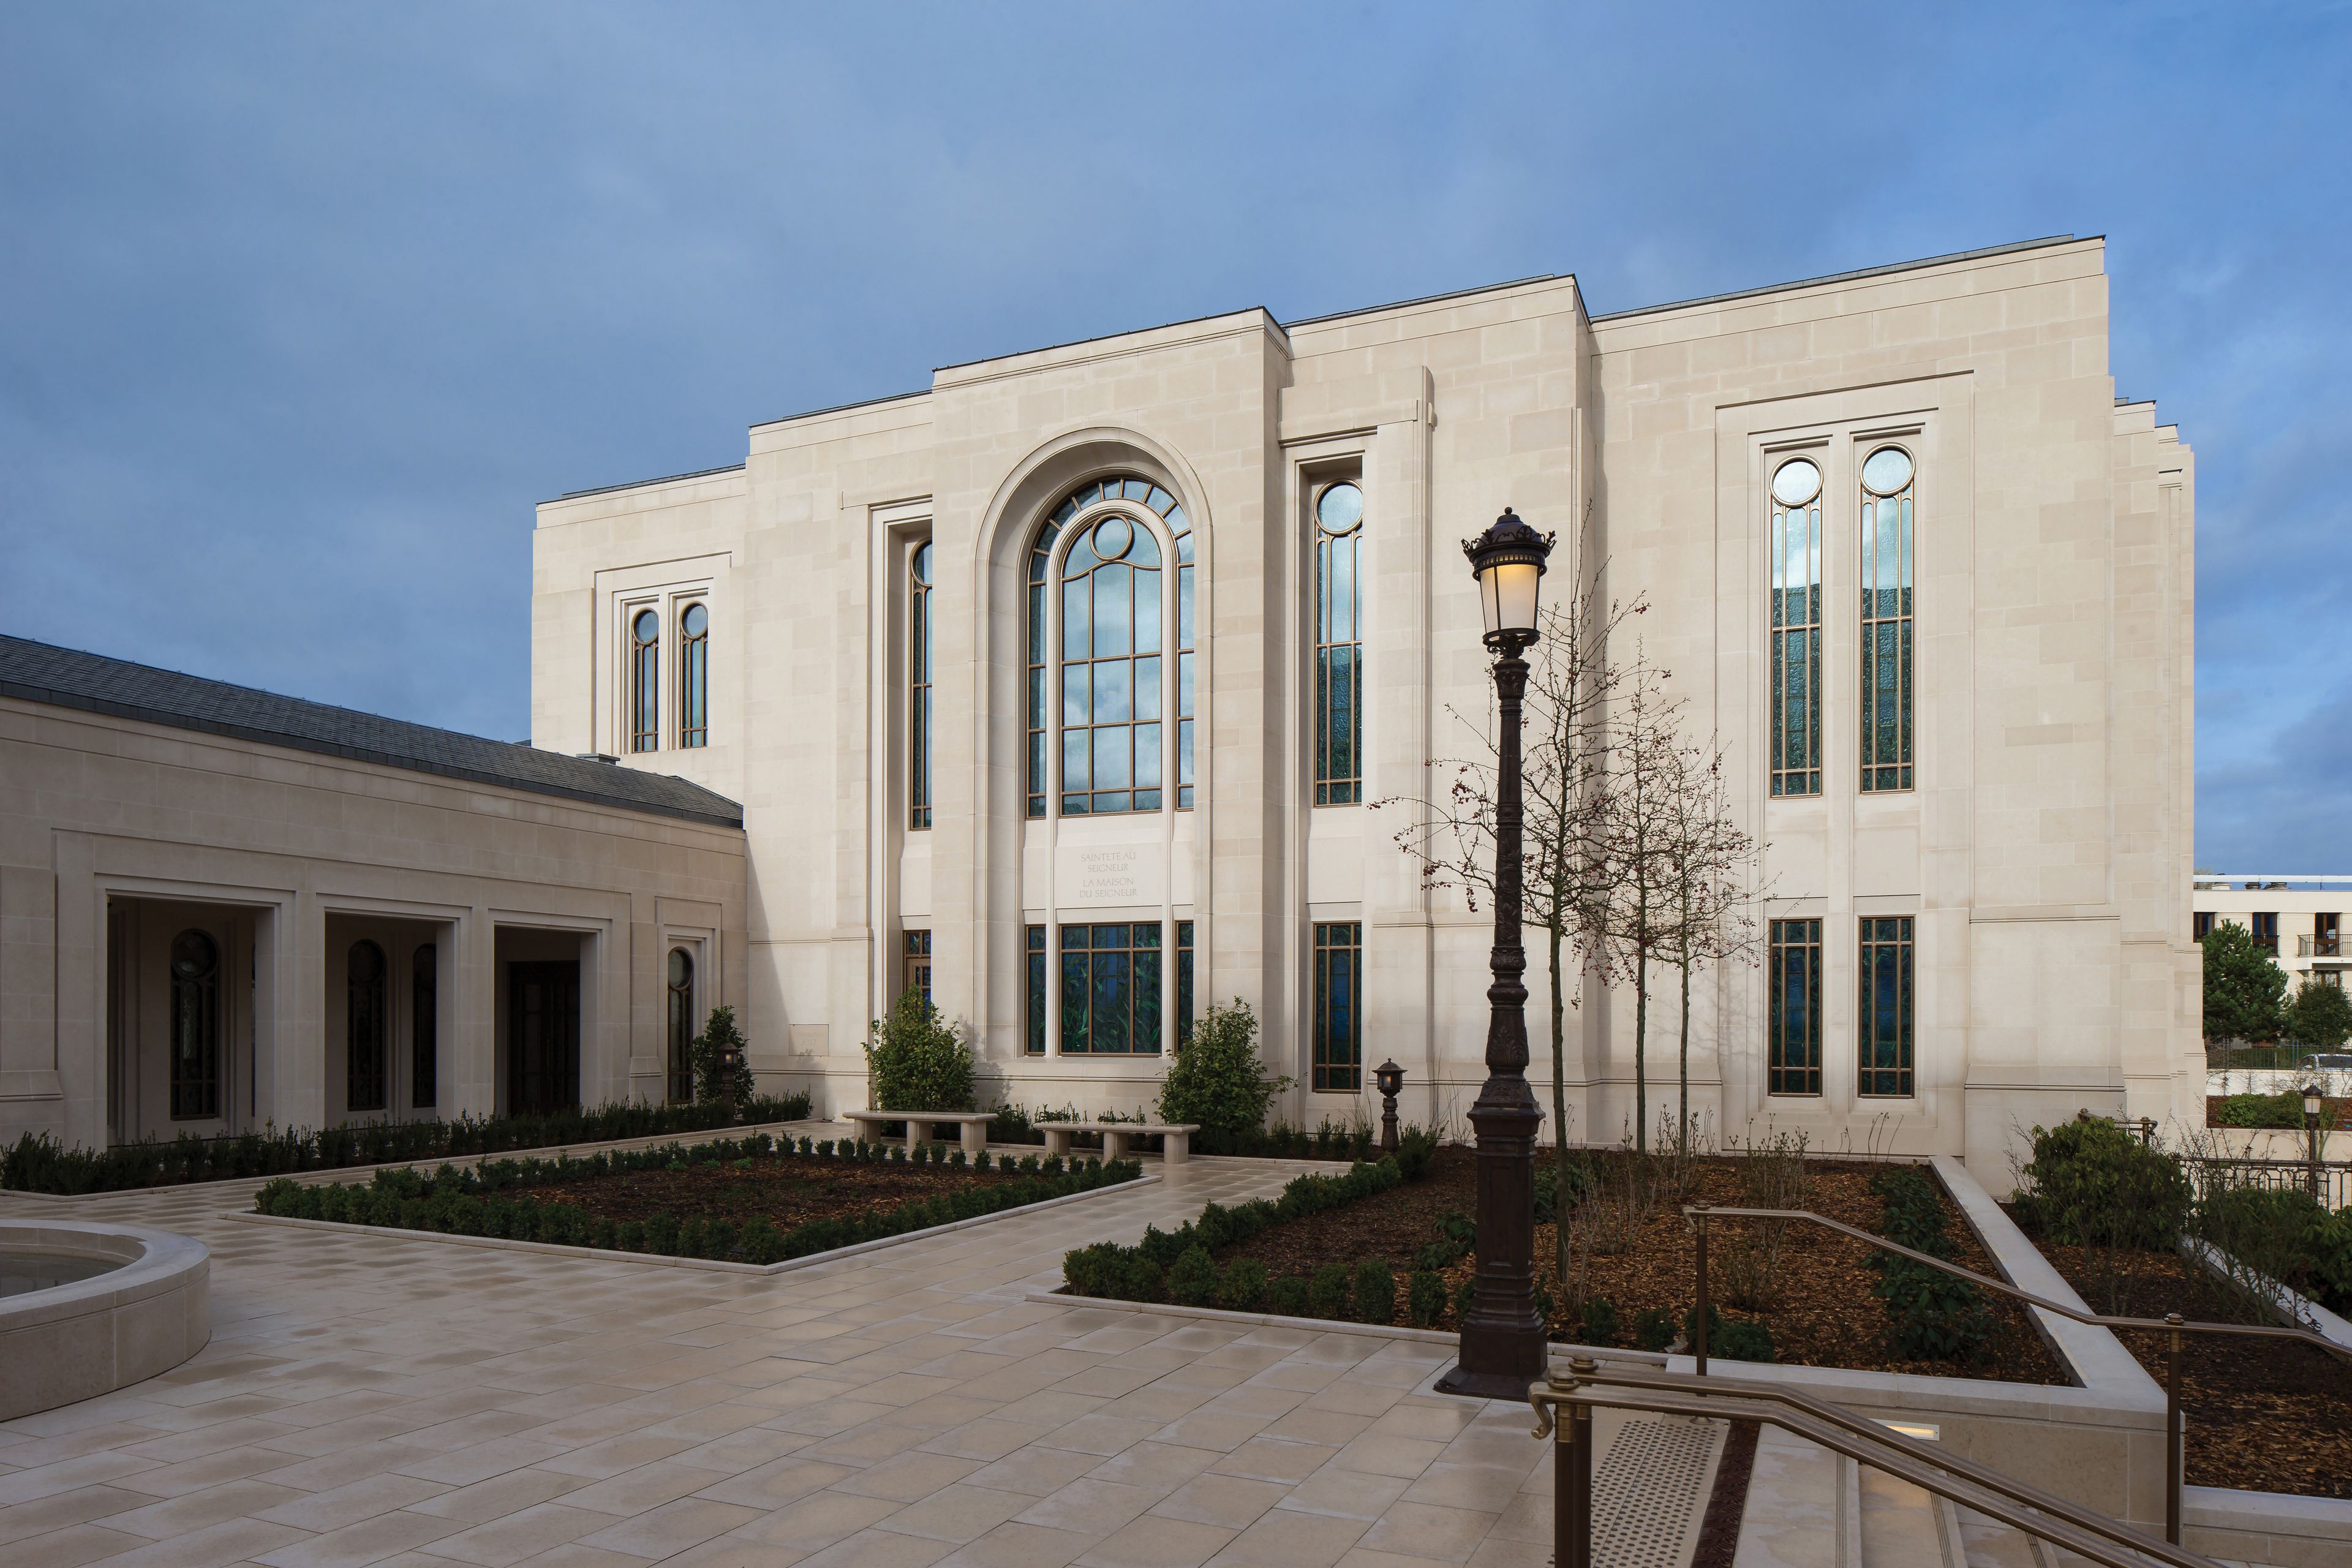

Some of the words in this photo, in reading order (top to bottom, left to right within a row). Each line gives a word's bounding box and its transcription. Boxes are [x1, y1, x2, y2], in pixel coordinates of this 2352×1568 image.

[1087, 863, 1128, 872] SEIGNEUR
[1096, 877, 1134, 886] MAISON
[1095, 888, 1137, 897] SEIGNEUR
